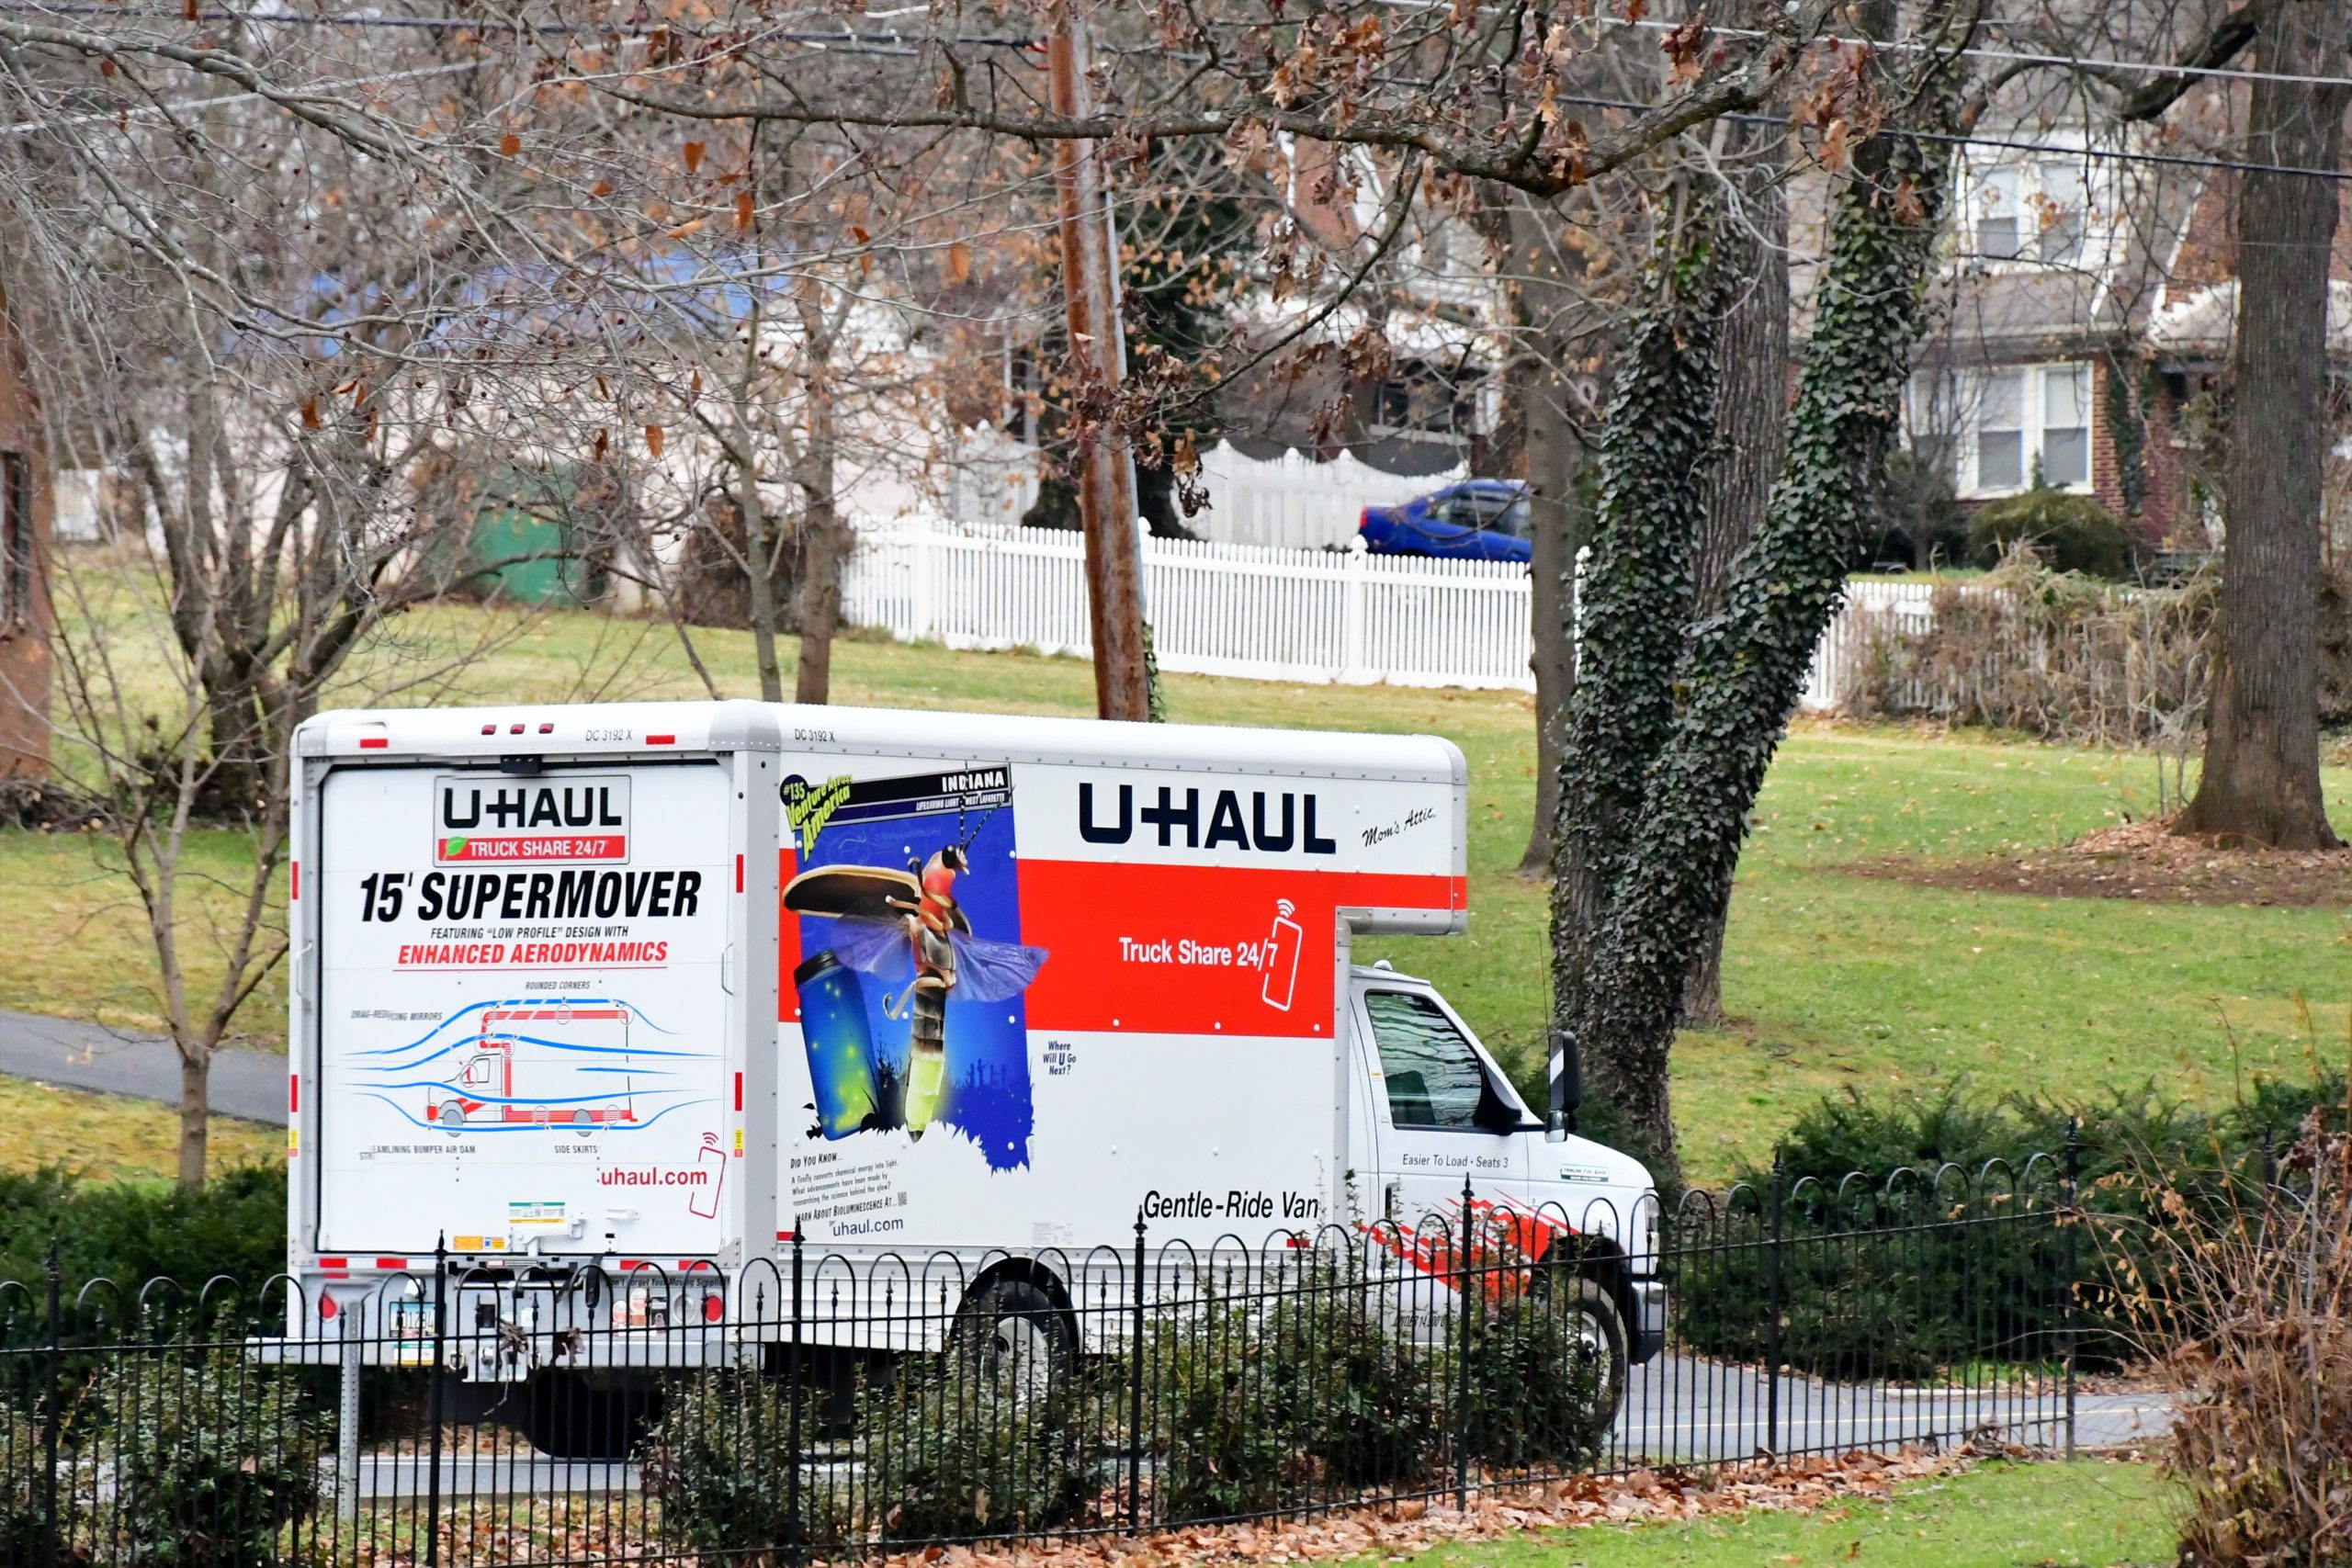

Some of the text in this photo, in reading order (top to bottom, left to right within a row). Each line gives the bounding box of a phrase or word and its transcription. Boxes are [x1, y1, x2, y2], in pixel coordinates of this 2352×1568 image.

[586, 728, 633, 741] DC 3192 X
[795, 728, 835, 742] DC 3192 X
[942, 771, 1005, 793] INDIANA
[783, 782, 806, 801] #135
[444, 787, 622, 829] U-HAUL
[786, 784, 827, 833] Venture
[916, 793, 1005, 811] LIFESAVING LIGHT WEST LAFAYETTE
[803, 784, 851, 864] America
[1080, 783, 1336, 854] U-HAUL
[1363, 807, 1433, 847] Mom's Attic
[469, 840, 606, 857] TRUCK SHARE 24/7
[360, 870, 702, 921] 15' SUPERMOVER
[431, 925, 629, 939] FEATURING "LOW PROFILE" DESIGN WITH
[398, 942, 668, 964] ENHANCED AERODYNAMICS
[1119, 937, 1278, 971] Truck Share 24/7
[526, 981, 591, 989] ROUNDED CORNERS
[410, 1012, 443, 1021] MIRRORS
[1048, 1040, 1071, 1051] Where
[1043, 1052, 1077, 1066] Will U Go
[1049, 1065, 1071, 1075] Next?
[413, 1145, 443, 1154] BUMPER
[446, 1145, 458, 1154] AIR
[459, 1145, 476, 1154] DAM
[554, 1145, 598, 1154] SIDE SKIRTS
[790, 1158, 801, 1169] DID
[804, 1156, 816, 1168] YOU
[1403, 1154, 1509, 1168] Easier To Load Seats 3
[602, 1168, 707, 1185] uhaul.com
[791, 1176, 796, 1185] A
[813, 1172, 833, 1181] converts
[835, 1166, 855, 1177] chemical
[857, 1165, 874, 1174] energy
[876, 1161, 884, 1169] into
[792, 1172, 888, 1195] What advancements have been made by
[793, 1196, 820, 1207] researching
[831, 1191, 848, 1200] science
[850, 1186, 865, 1196] behind
[876, 1181, 891, 1193] glow?
[813, 1207, 831, 1220] ABOUT
[833, 1199, 883, 1217] BIOLUMINESCENCE
[1144, 1190, 1318, 1218] Gentle-Ride Van
[832, 1218, 903, 1236] uhaul.com
[627, 1278, 649, 1288] orget
